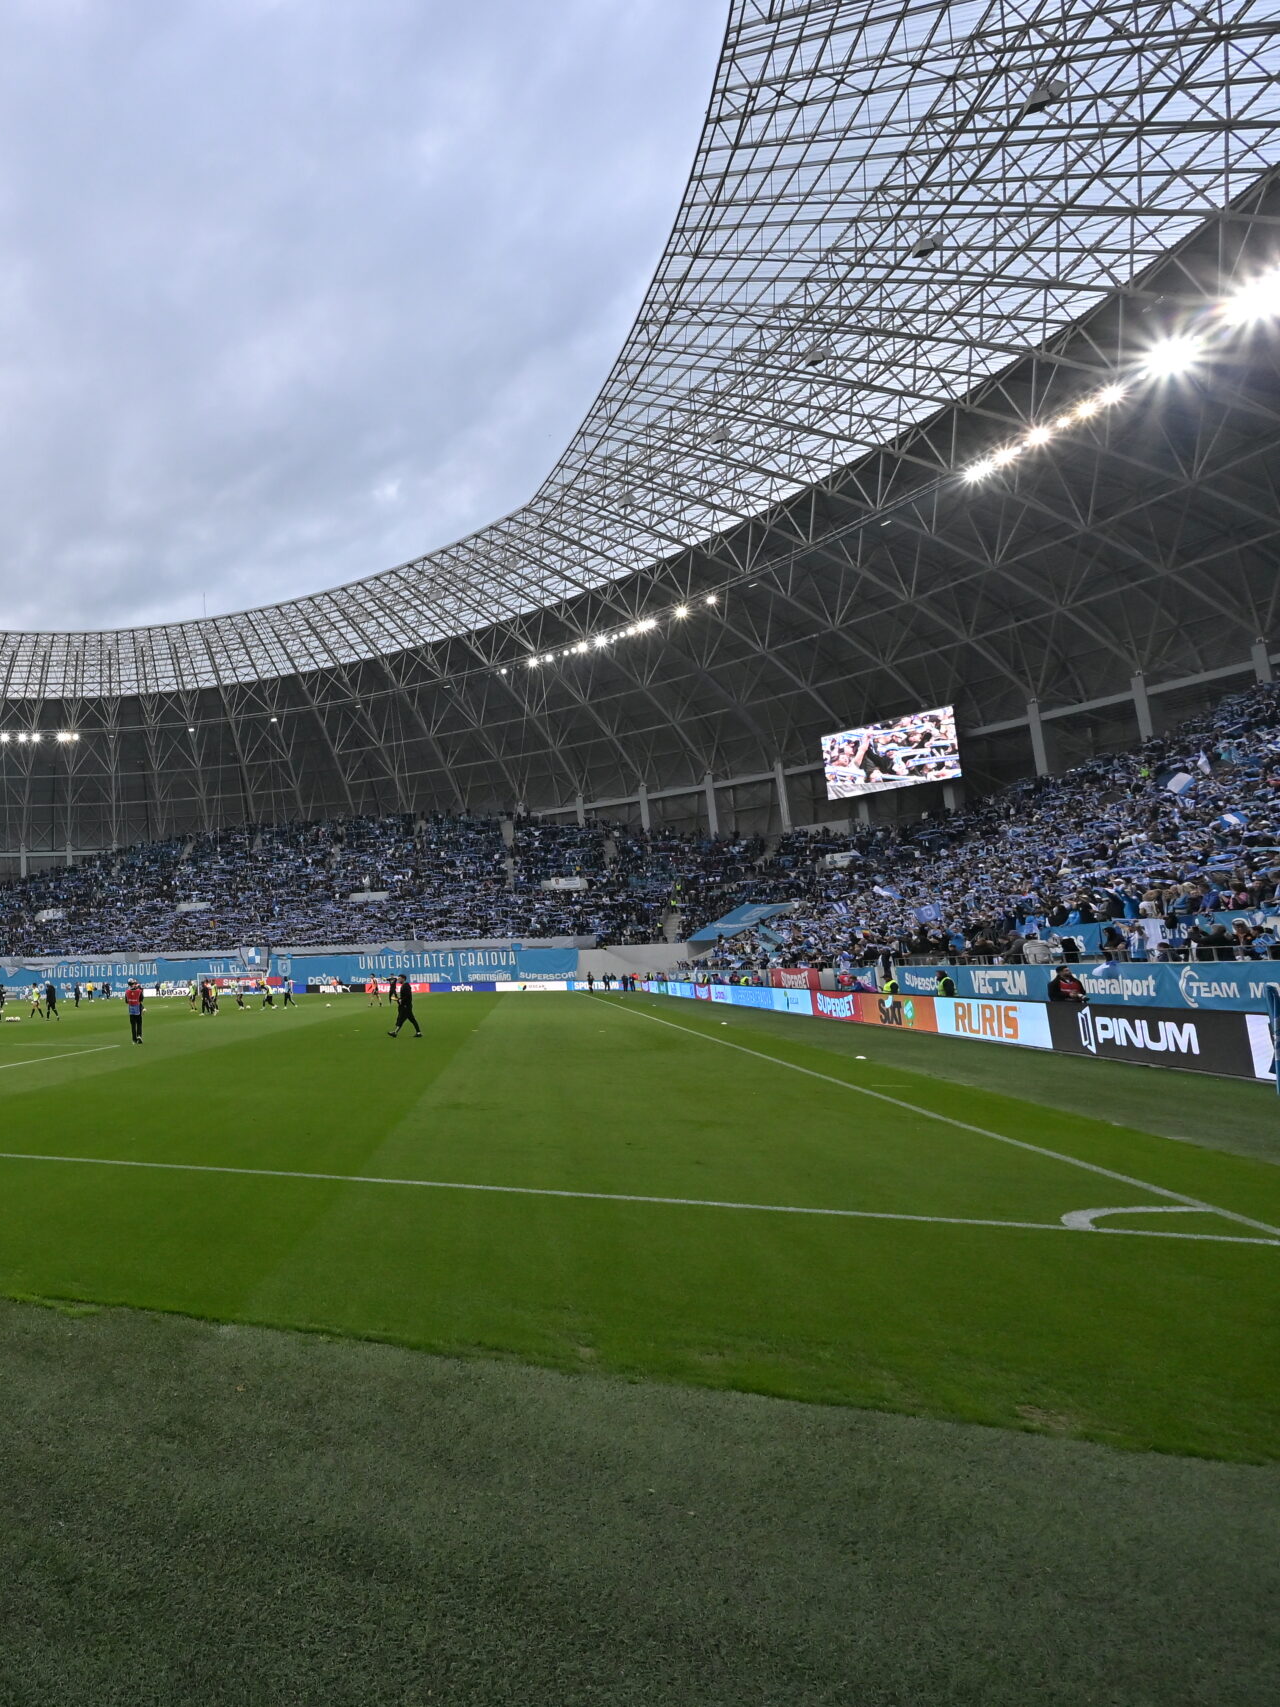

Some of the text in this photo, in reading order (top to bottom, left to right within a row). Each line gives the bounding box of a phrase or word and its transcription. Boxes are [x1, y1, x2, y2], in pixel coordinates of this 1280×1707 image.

[359, 951, 516, 969] UNIVERSITATEA CRAIOVA
[41, 963, 158, 979] UNIVERSITATEA CRAIOVA
[410, 973, 439, 982] PUMA
[1189, 981, 1240, 998] TEAM
[817, 992, 854, 1018] SUPERBET
[954, 1002, 1019, 1040] RURIS
[1094, 1016, 1200, 1055] PINUM
